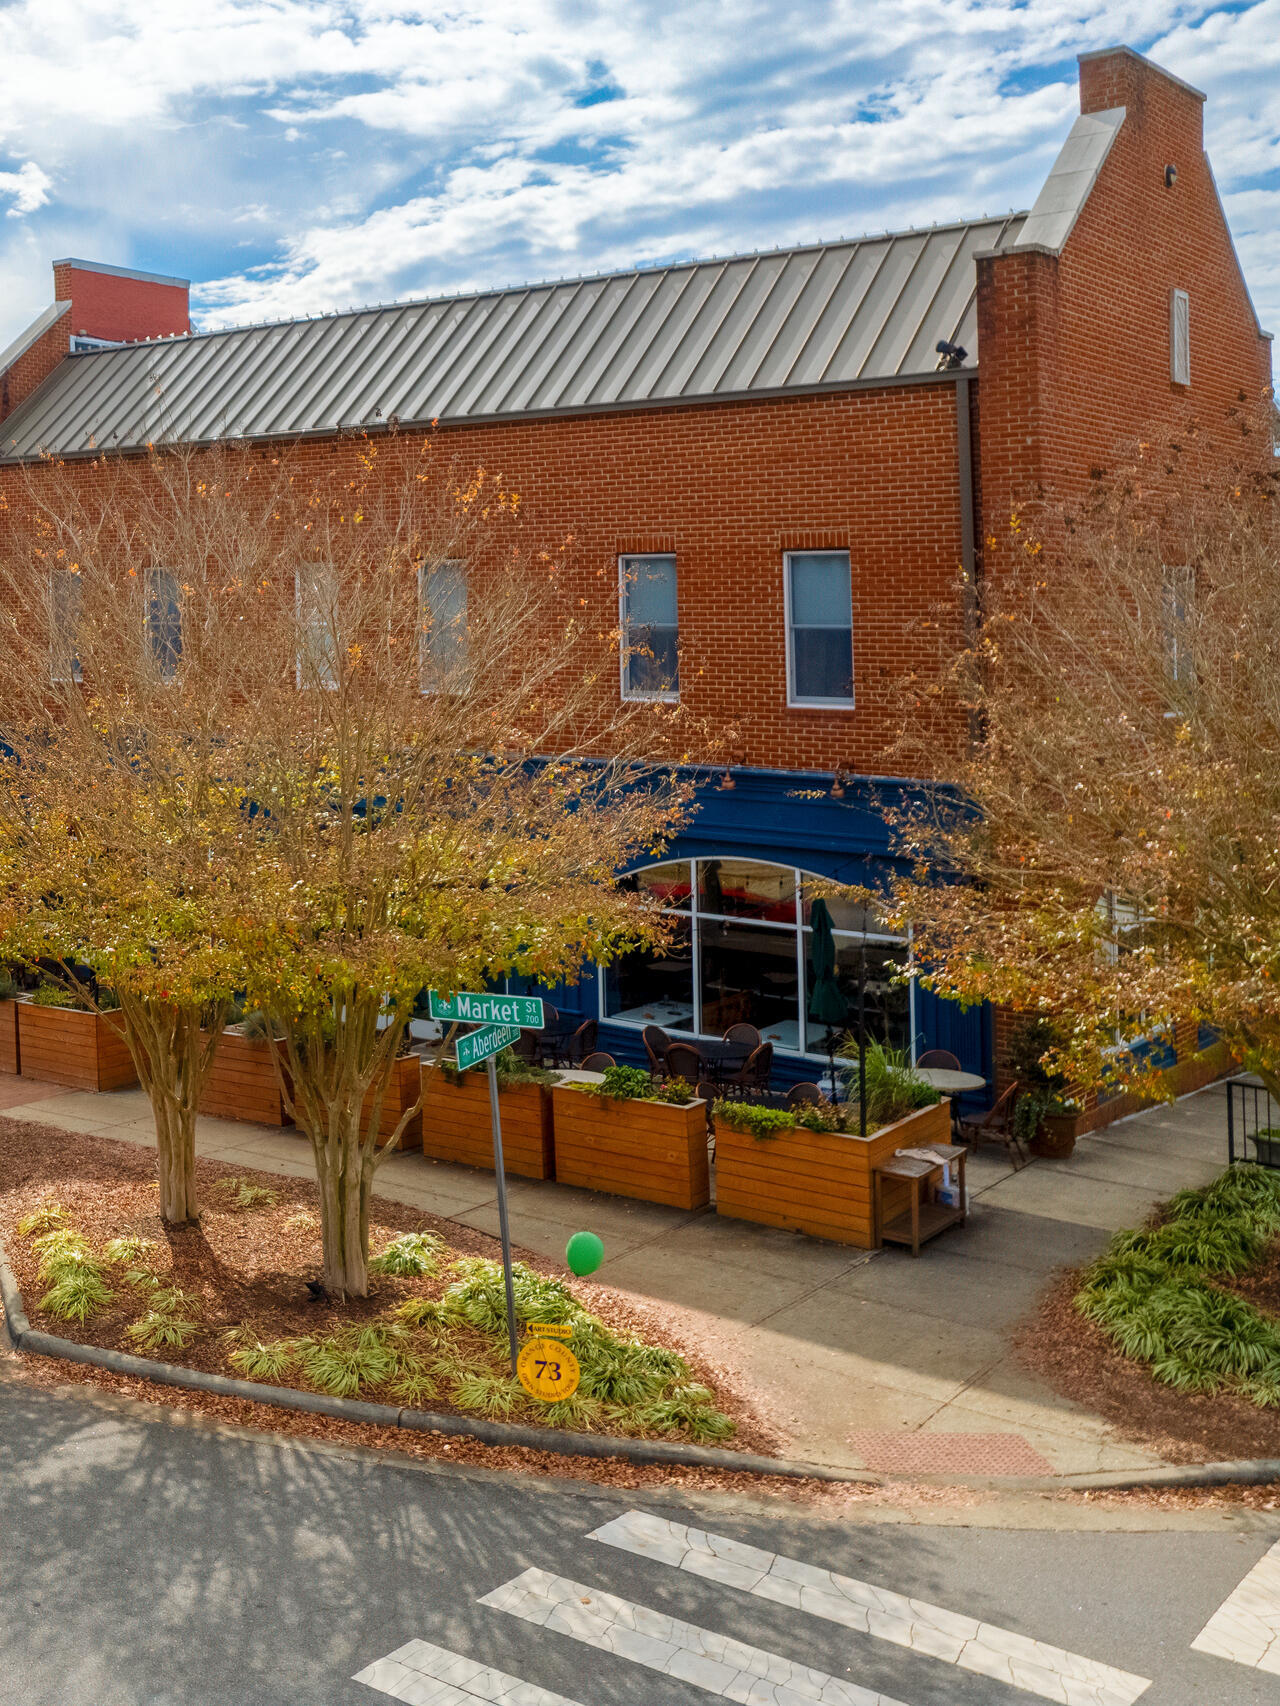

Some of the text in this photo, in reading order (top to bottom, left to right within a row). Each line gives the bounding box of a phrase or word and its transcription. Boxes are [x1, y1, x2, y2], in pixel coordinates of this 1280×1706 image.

[457, 996, 520, 1022] Market
[525, 1001, 536, 1013] St
[525, 1015, 539, 1024] 700
[473, 1025, 511, 1059] Aberdeen
[546, 1327, 572, 1335] STUDIO
[521, 1343, 577, 1373] ORANGE COUNTY
[535, 1360, 562, 1382] 73
